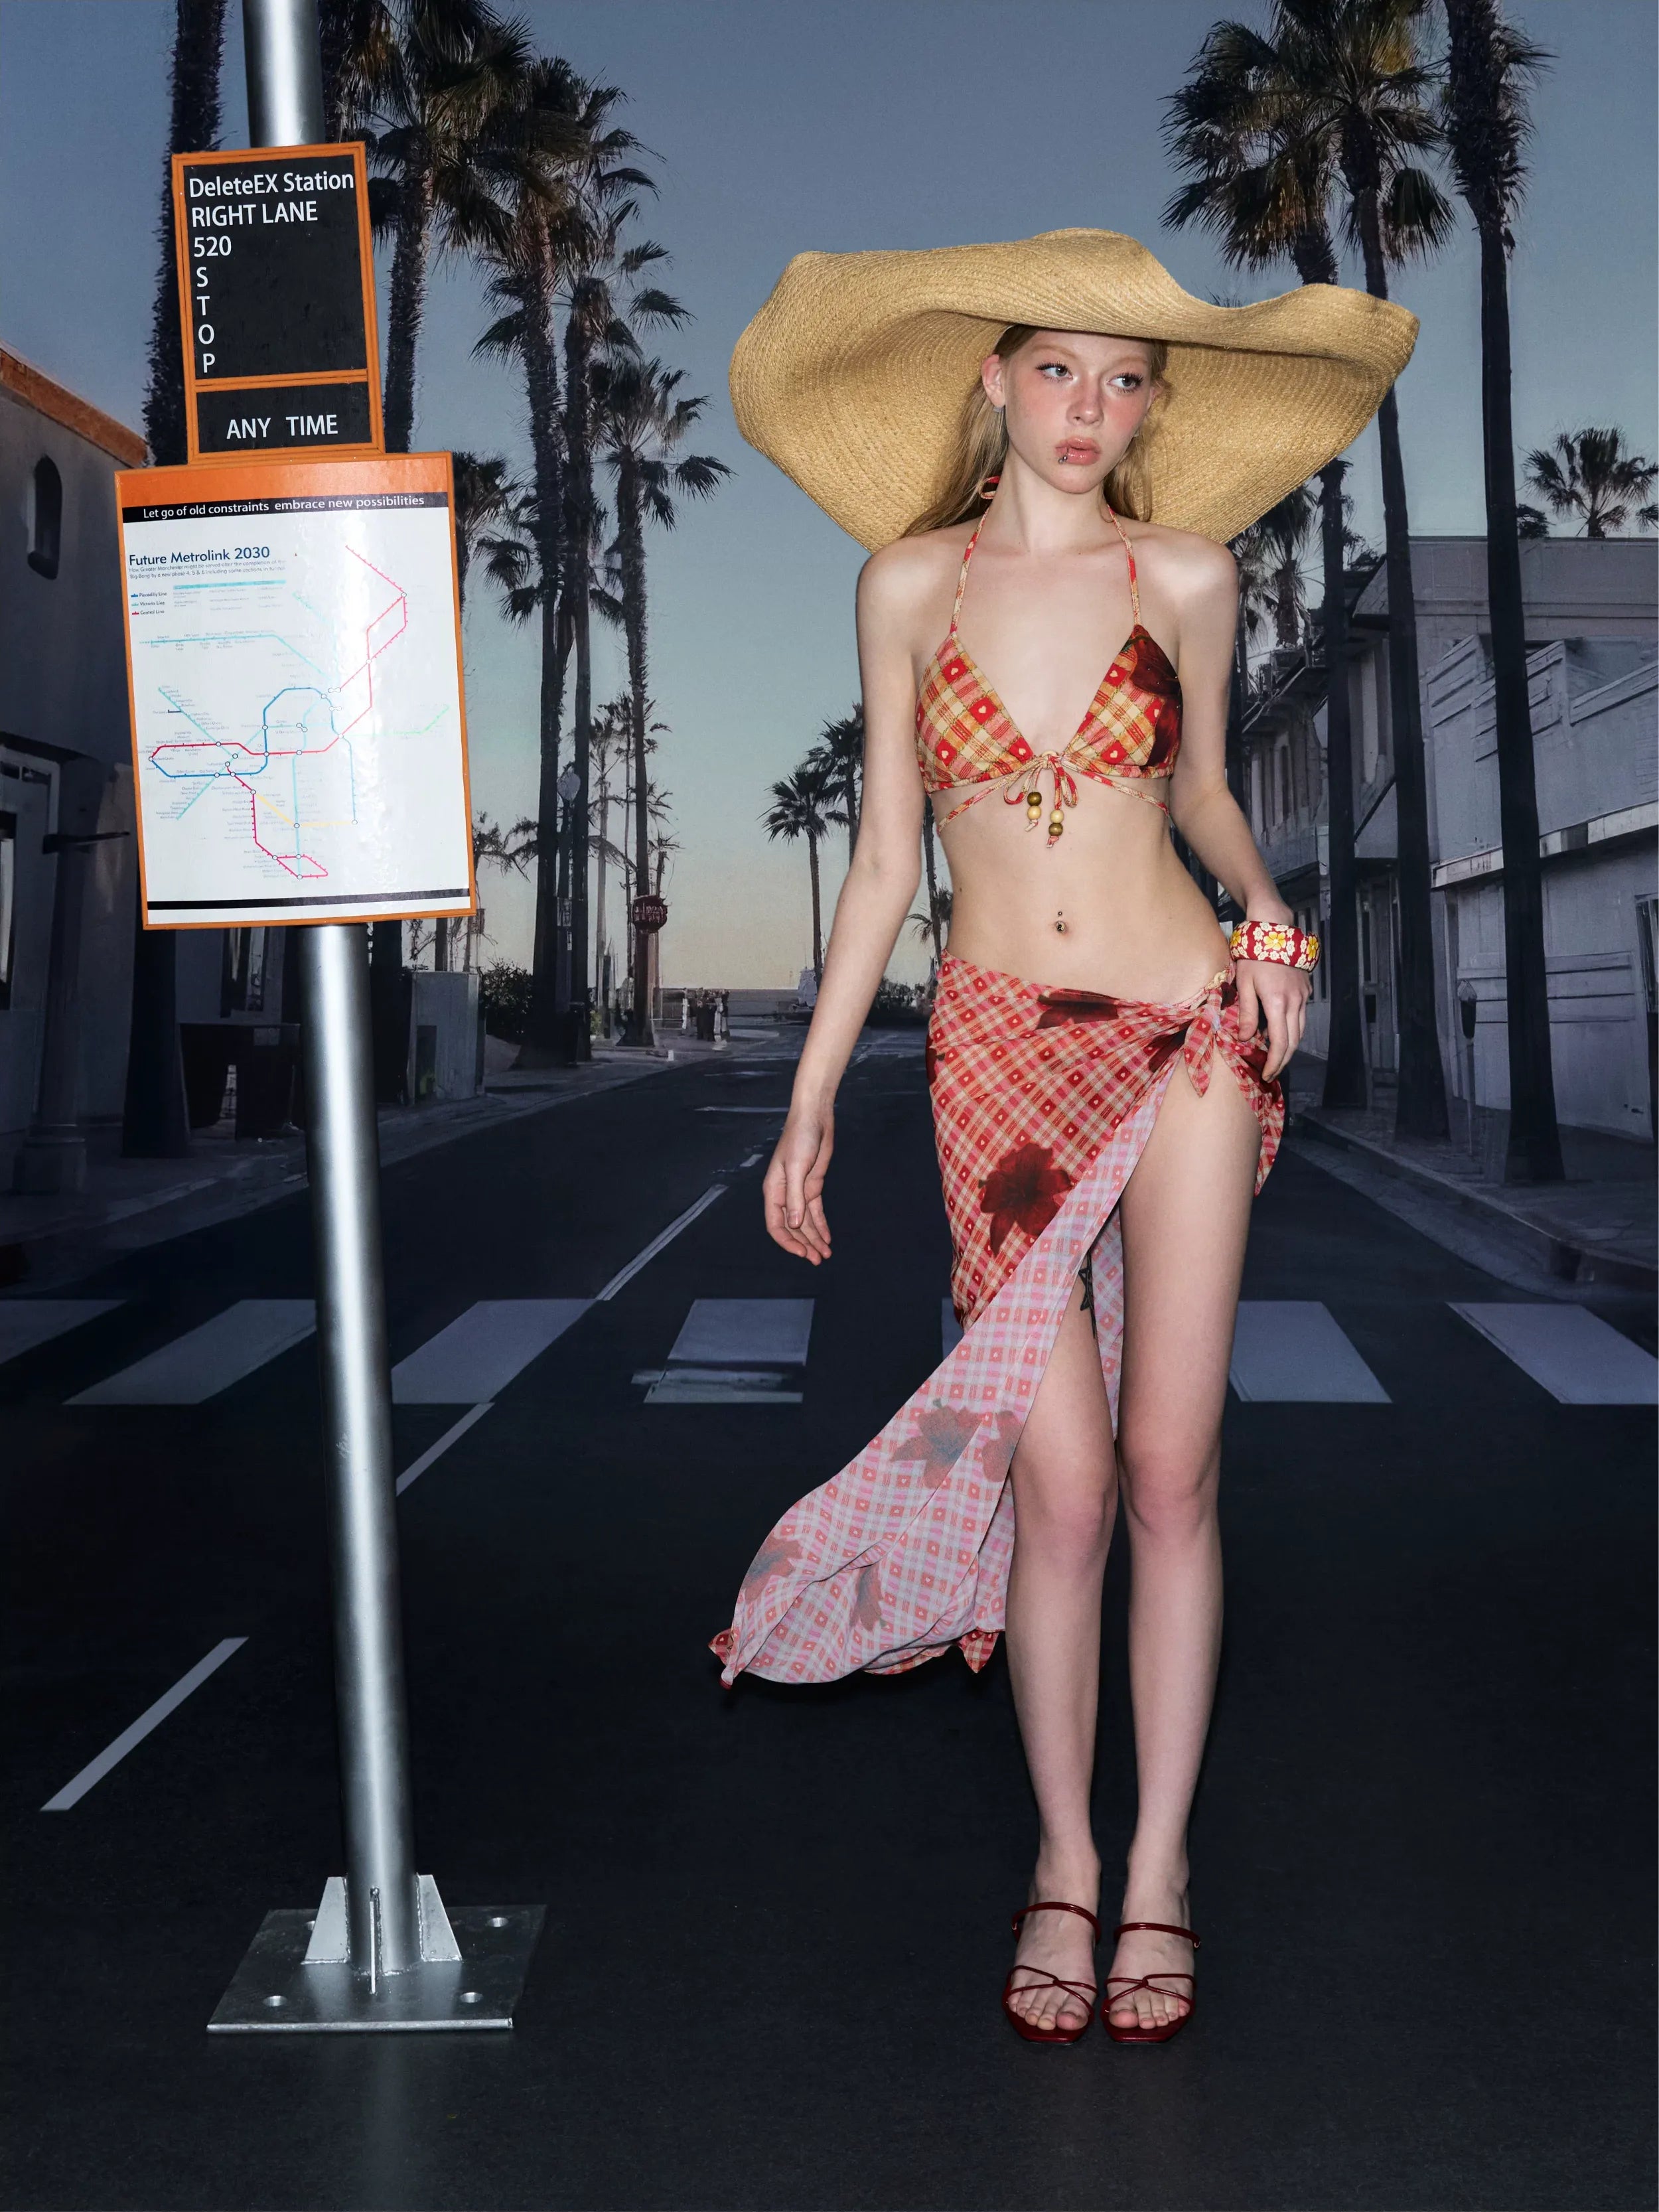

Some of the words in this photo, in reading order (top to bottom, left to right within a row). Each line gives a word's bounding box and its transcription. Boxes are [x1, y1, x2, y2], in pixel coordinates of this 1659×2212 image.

[189, 174, 279, 198] DeleteEX
[283, 171, 354, 192] Station
[192, 204, 256, 227] RIGHT
[262, 201, 318, 224] LANE
[194, 236, 232, 258] 520
[226, 417, 271, 439] ANY
[286, 414, 338, 436] TIME
[143, 508, 159, 518] Let
[161, 509, 174, 520] go
[177, 506, 187, 516] of
[189, 505, 206, 514] old
[208, 502, 269, 514] constraints
[275, 498, 325, 510] embrace
[356, 496, 425, 508] possibilities
[129, 554, 167, 565] Future
[171, 549, 230, 563] Metrolink
[234, 547, 270, 559] 2030
